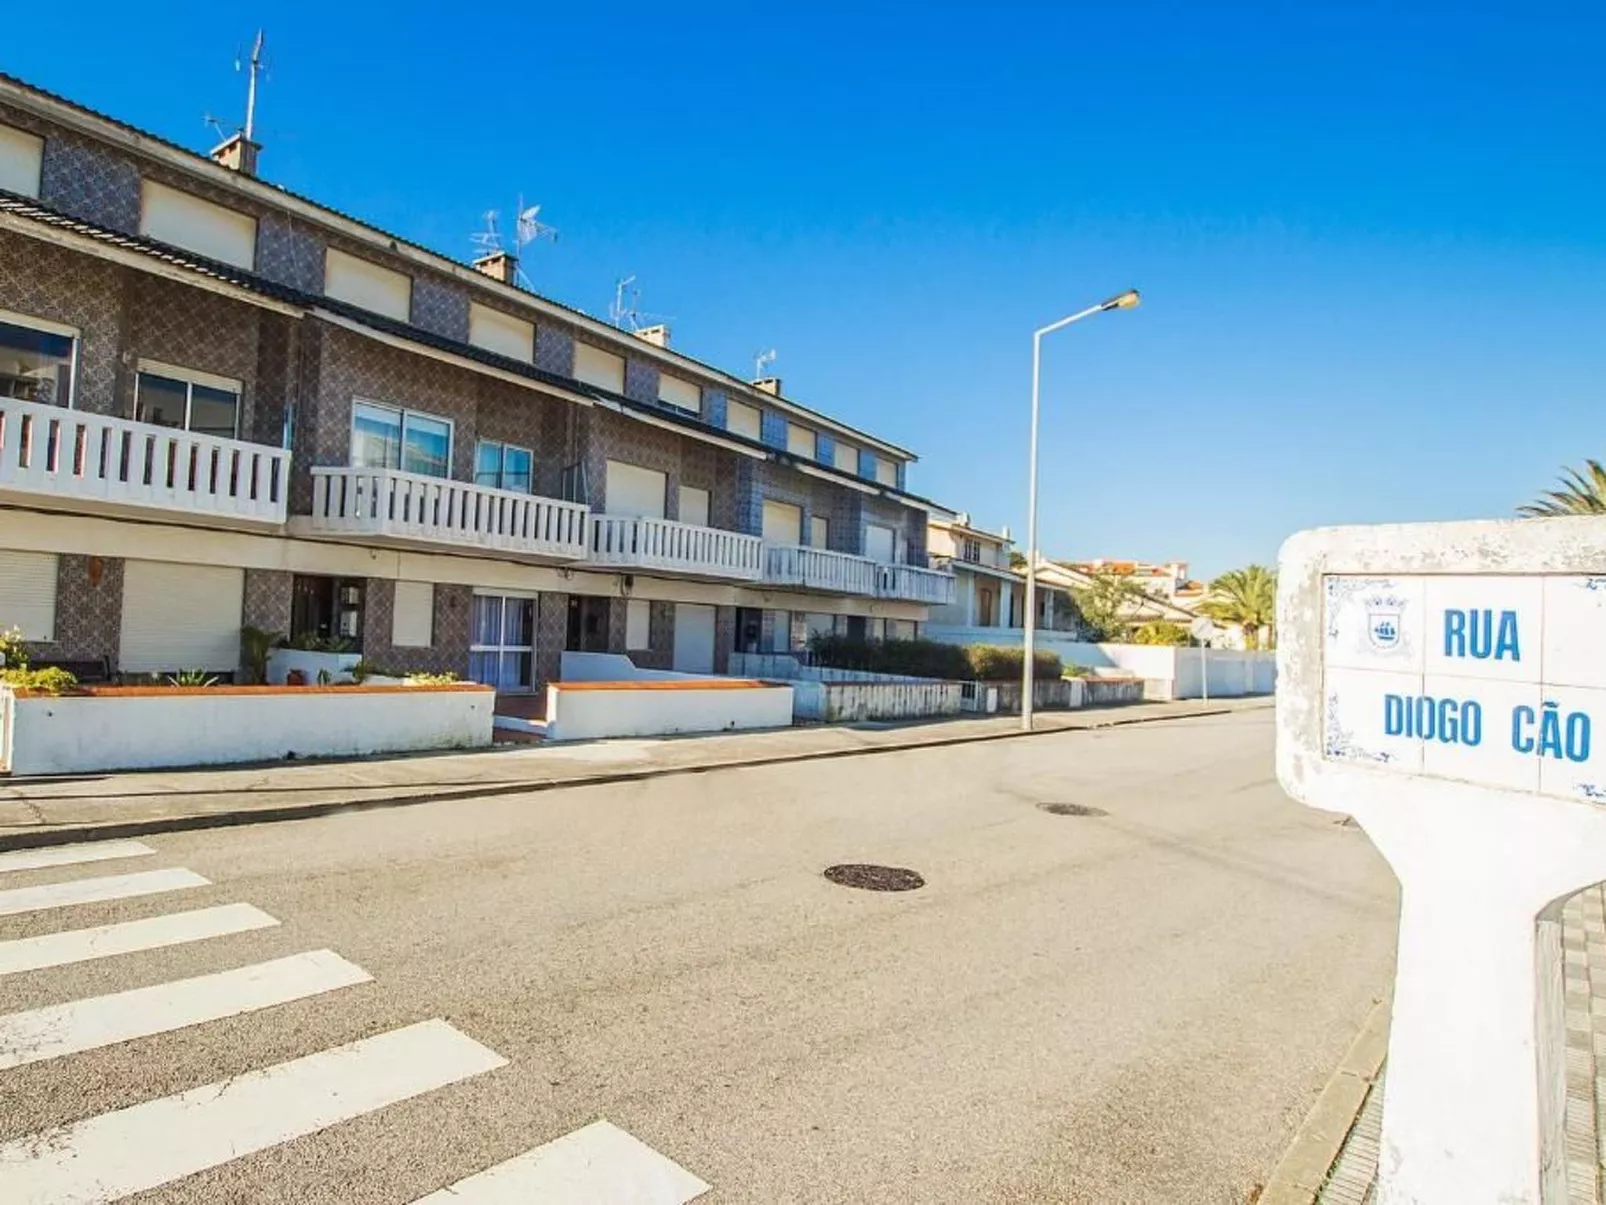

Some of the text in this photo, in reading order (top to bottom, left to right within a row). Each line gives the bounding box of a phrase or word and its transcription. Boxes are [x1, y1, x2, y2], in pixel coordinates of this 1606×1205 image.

[1444, 609, 1520, 661] RUA
[1384, 694, 1591, 762] DIOGO CÃO
